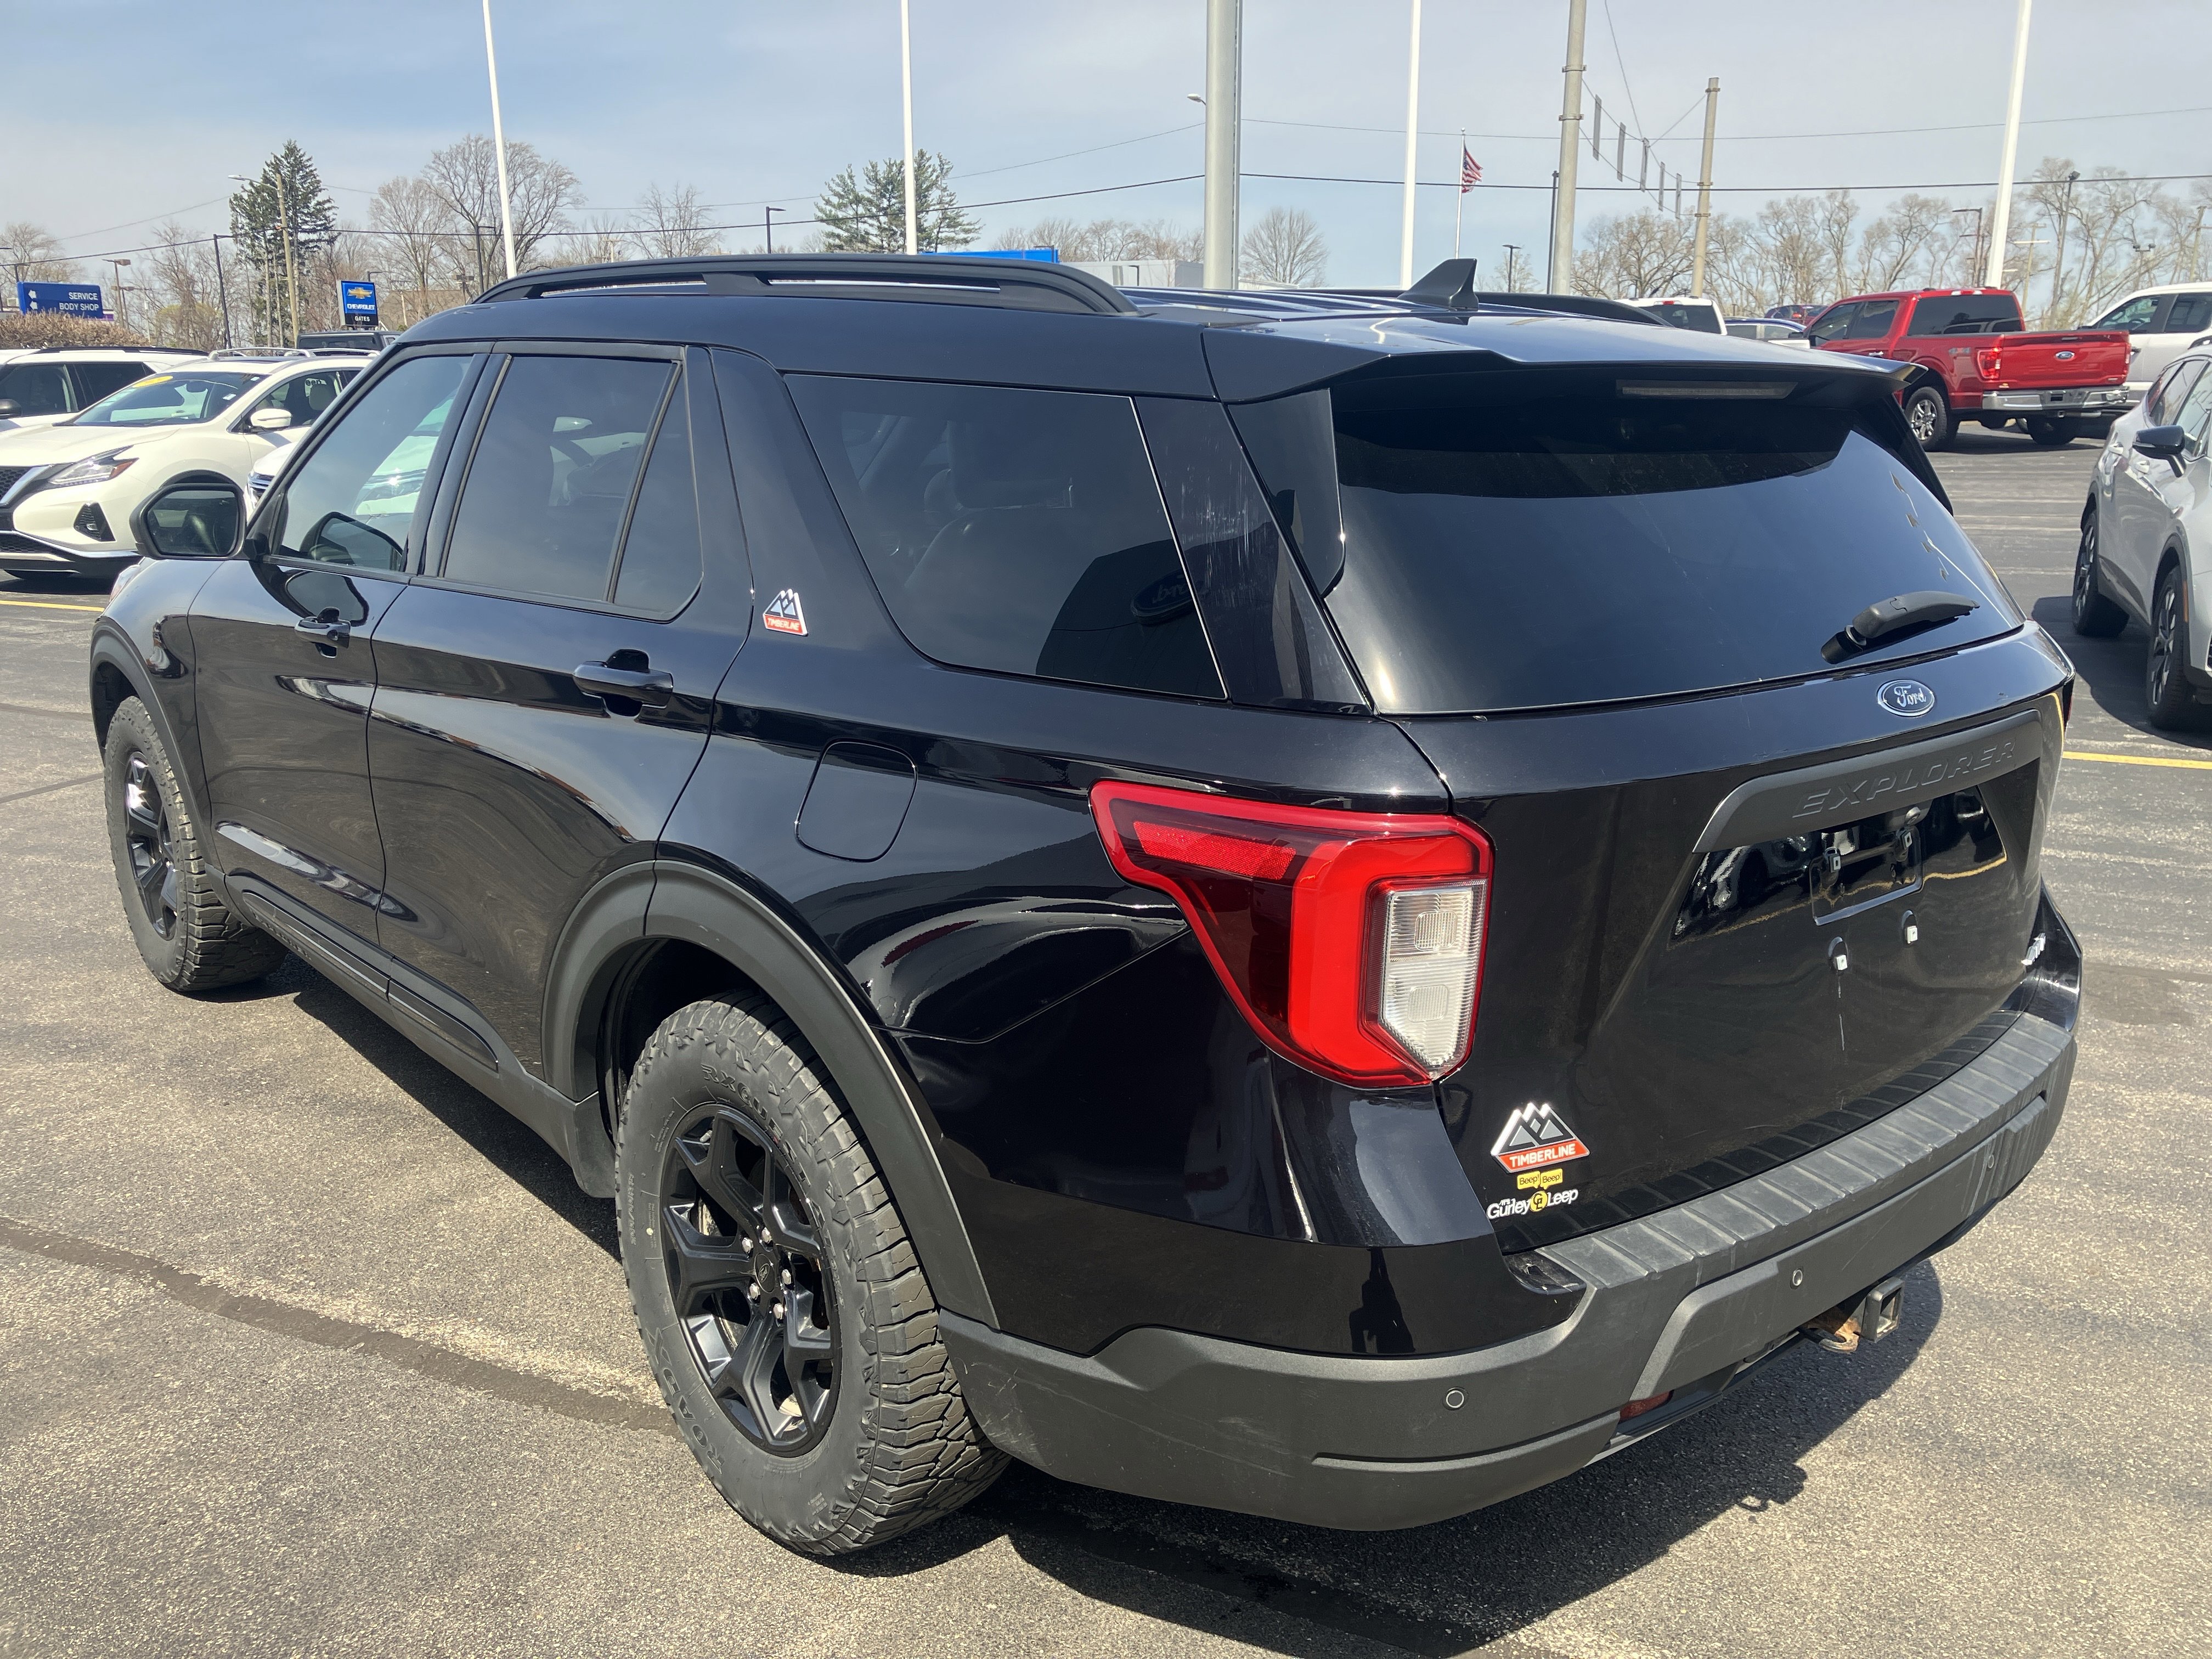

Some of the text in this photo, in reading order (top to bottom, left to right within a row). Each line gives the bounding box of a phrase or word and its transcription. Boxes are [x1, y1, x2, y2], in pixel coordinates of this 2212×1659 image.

[69, 292, 98, 300] SERVICE
[768, 618, 799, 631] TIMBERLINE
[1894, 685, 1927, 707] Ford
[1792, 739, 2017, 818] EXPLORER
[1509, 1143, 1576, 1167] TIMBERLINE
[1519, 1172, 1562, 1185] Beep! Beep!
[1486, 1198, 1530, 1220] Gurley
[1547, 1189, 1578, 1207] Leep
